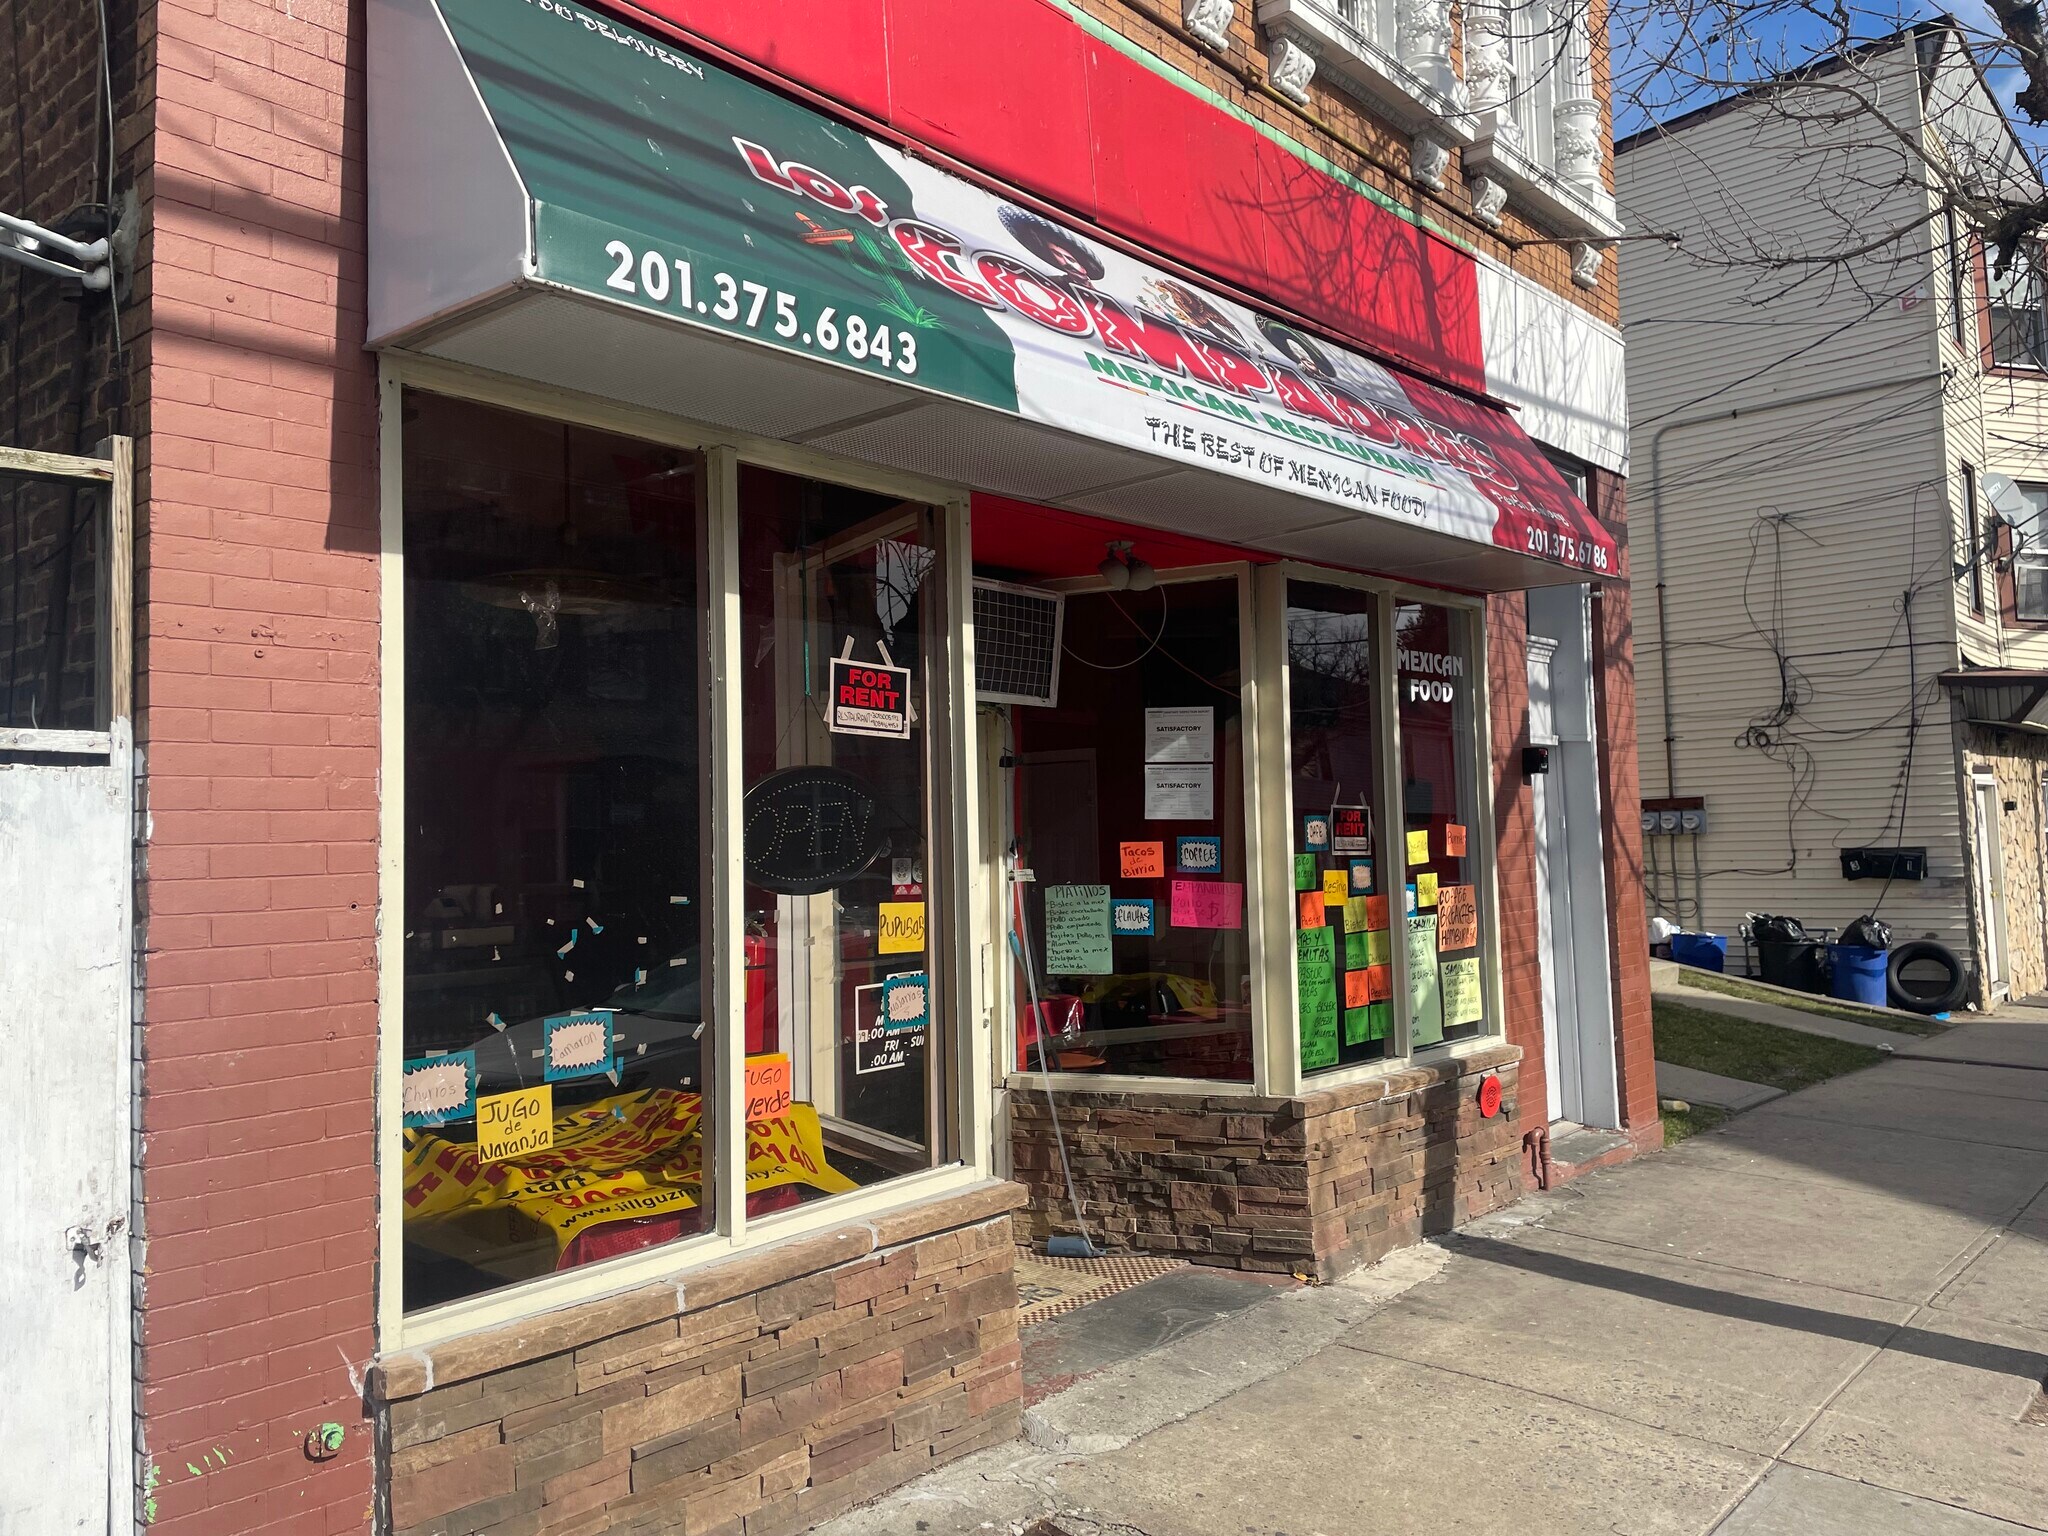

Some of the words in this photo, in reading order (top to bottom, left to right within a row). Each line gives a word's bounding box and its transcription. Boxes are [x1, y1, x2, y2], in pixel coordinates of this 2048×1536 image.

[575, 11, 704, 80] DELIVERY
[731, 135, 889, 229] LOS
[604, 240, 918, 376] 201.375.6843
[886, 217, 1521, 491] COMPADRES
[1083, 350, 1260, 425] MEXICAN
[1259, 409, 1437, 483] RESTAURANT
[1144, 416, 1196, 452] THE
[1199, 432, 1255, 468] BEST
[1260, 450, 1285, 477] OF
[1288, 459, 1379, 506] MEXICAN
[1526, 525, 1608, 570] 201.375.6786
[1397, 648, 1464, 678] MEXICAN
[849, 668, 891, 690] FOR
[1410, 678, 1454, 703] FOOD
[840, 685, 900, 710] RENT
[1156, 725, 1202, 733] SATISFACTORY
[1341, 810, 1361, 822] FOR
[1335, 822, 1366, 836] RENT
[1121, 846, 1155, 857] Tacos
[1129, 857, 1143, 865] de
[1184, 847, 1216, 862] COFFEE
[1122, 864, 1156, 877] Birria
[1298, 948, 1330, 962] EMITAS
[552, 1030, 598, 1063] Camaron
[884, 1039, 900, 1052] FRI
[889, 1050, 904, 1064] AM
[481, 1097, 541, 1124] JUGO
[504, 1120, 522, 1136] de
[479, 1128, 549, 1163] Naranja
